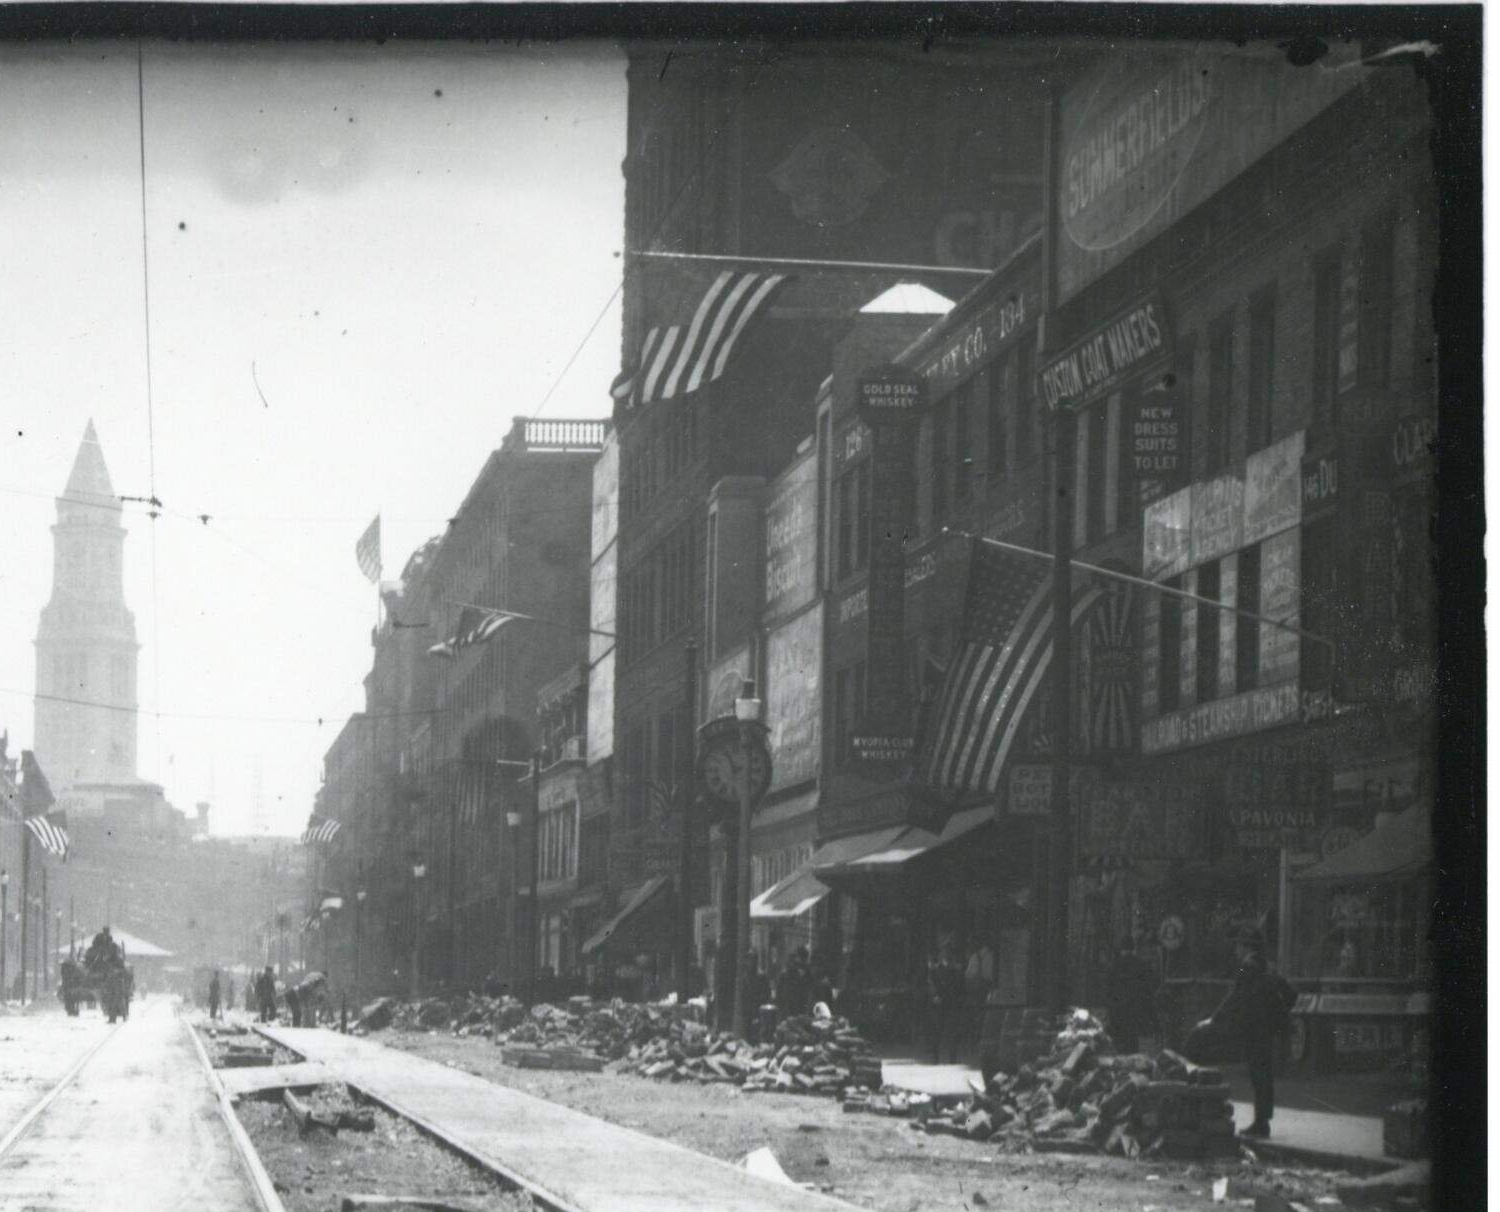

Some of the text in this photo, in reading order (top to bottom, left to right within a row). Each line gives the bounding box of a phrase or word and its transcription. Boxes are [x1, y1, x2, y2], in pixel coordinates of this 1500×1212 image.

[1106, 303, 1162, 369] MAKERS
[863, 384, 919, 395] GOLD SEAL
[868, 396, 914, 407] WHISKEY
[1140, 407, 1173, 419] NEW
[1134, 422, 1178, 435] DRESS
[1134, 438, 1178, 451] SUITS
[1134, 456, 1178, 469] TO LET
[861, 749, 907, 760] WHISKEY
